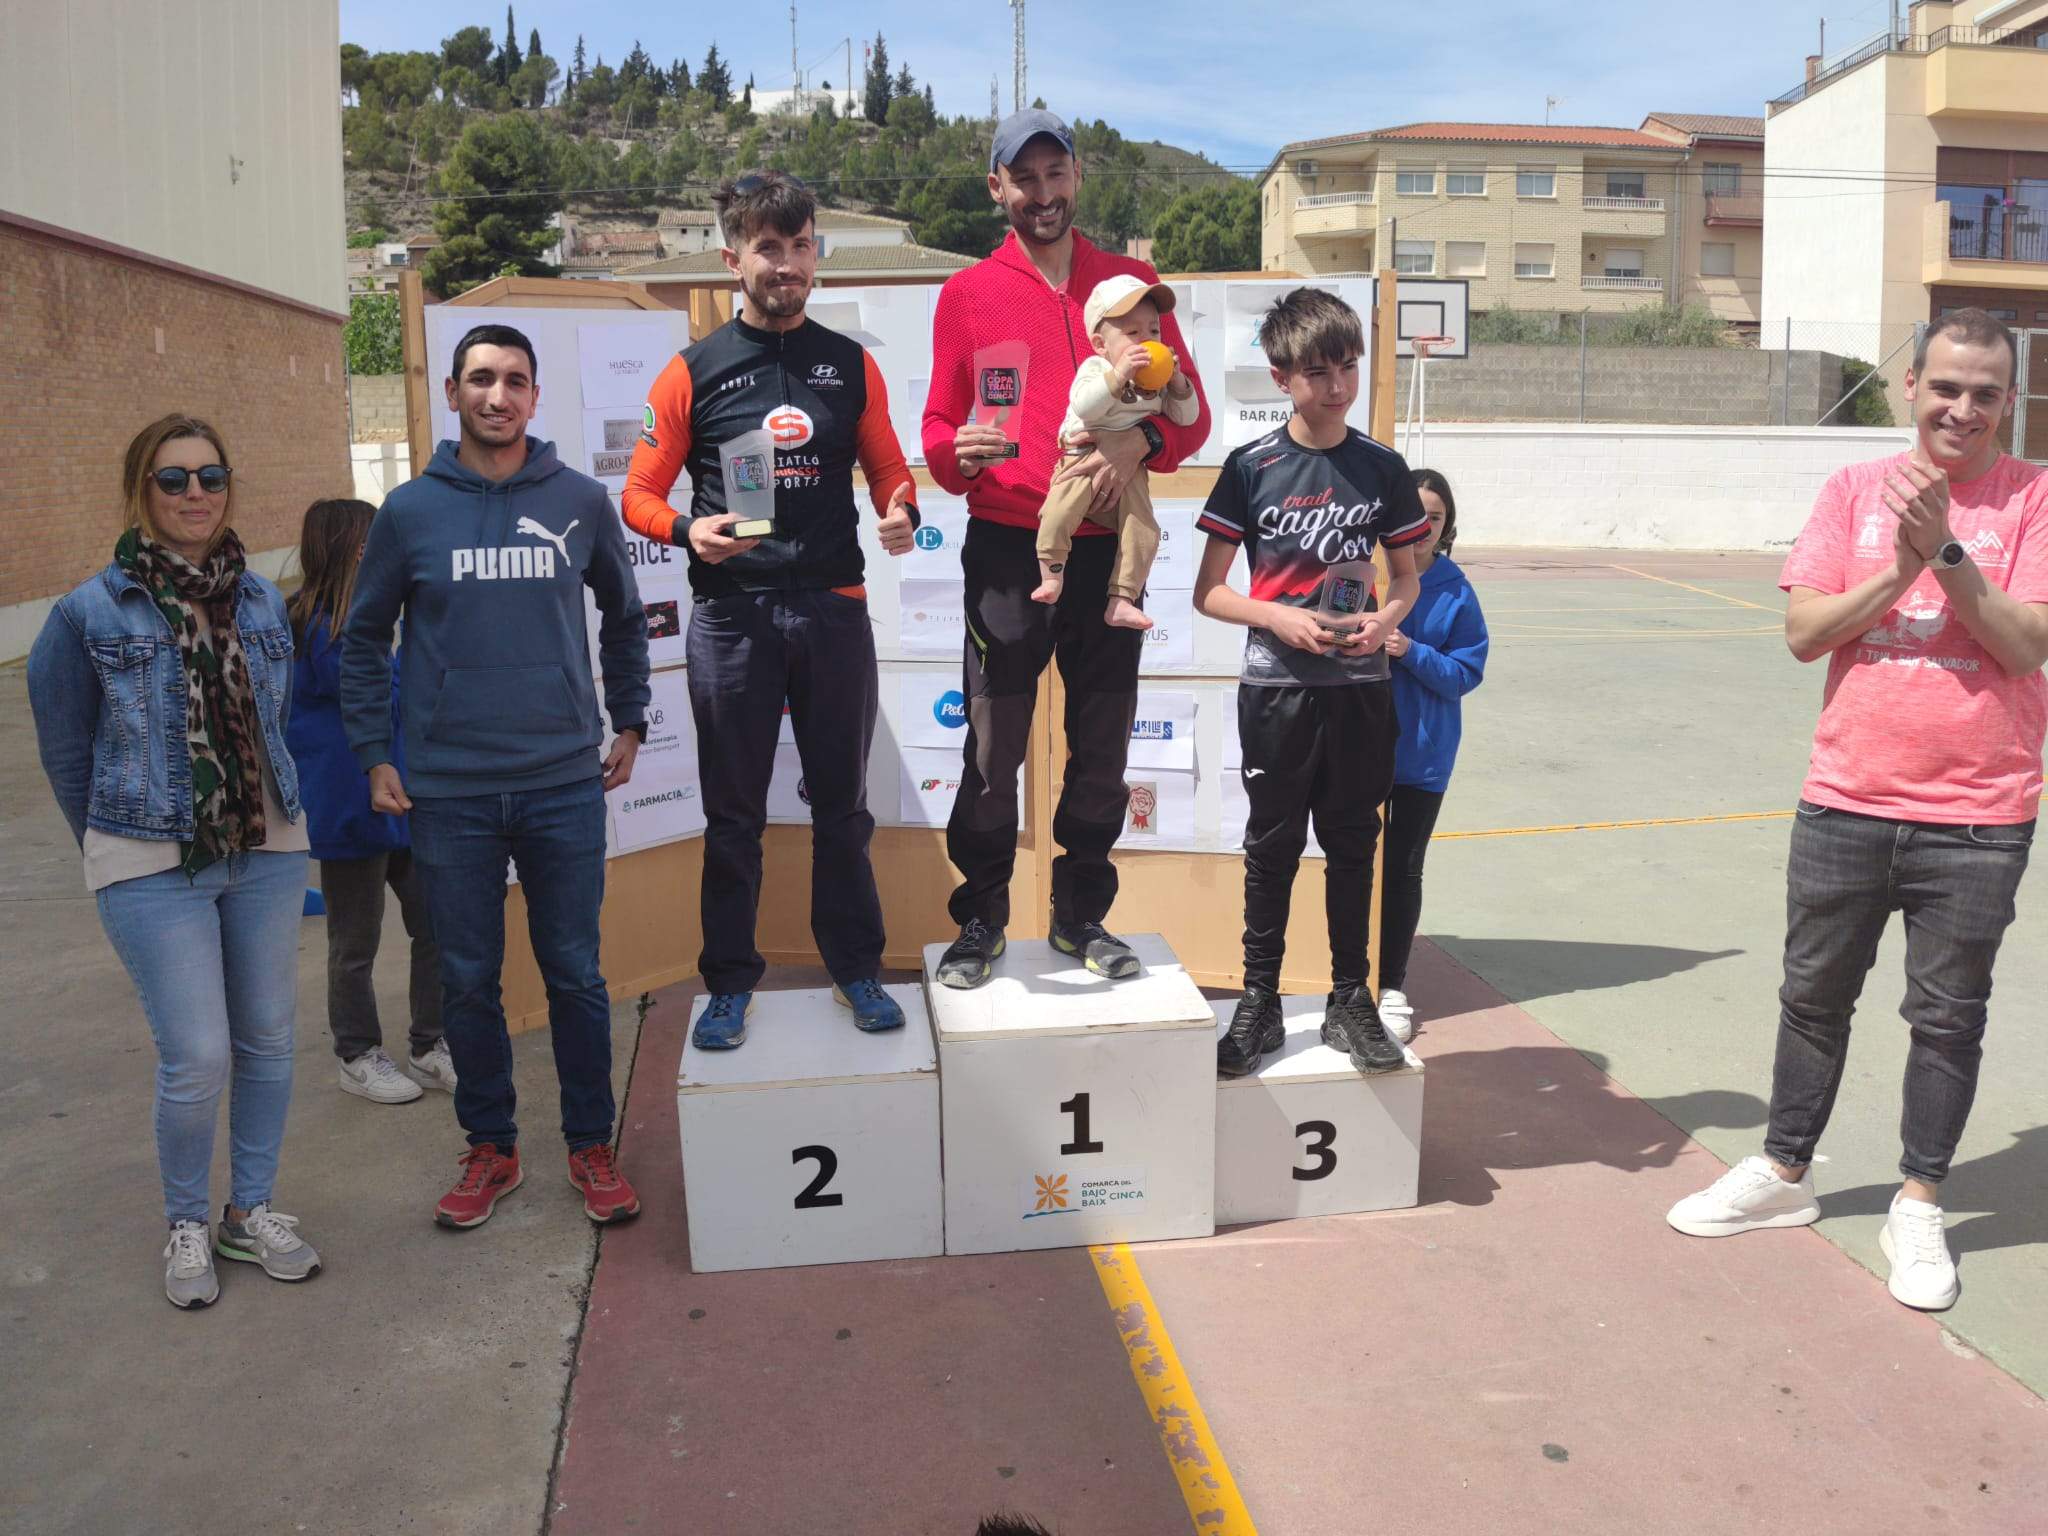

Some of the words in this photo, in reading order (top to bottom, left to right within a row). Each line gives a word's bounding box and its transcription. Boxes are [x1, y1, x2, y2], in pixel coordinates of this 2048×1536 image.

[807, 377, 844, 386] HYUNDAI
[987, 376, 1013, 384] COPA
[988, 383, 1014, 391] TRAIL
[987, 392, 1014, 400] CINCA
[1240, 410, 1267, 422] BAR
[769, 414, 808, 442] S
[774, 454, 819, 467] IATLÓ
[774, 477, 820, 489] PORTS
[1283, 487, 1333, 509] trail
[1317, 529, 1373, 563] Cor
[452, 547, 555, 581] PUMA
[1924, 656, 1981, 672] SALVADOR
[634, 789, 684, 810] FARMACIA
[1060, 1092, 1103, 1156] 1
[1292, 1120, 1338, 1181] 3
[792, 1144, 843, 1209] 2
[1081, 1180, 1120, 1188] COMARCA
[1081, 1189, 1107, 1198] BAJO
[1109, 1191, 1144, 1200] CINCA
[1081, 1198, 1107, 1207] BAIX
